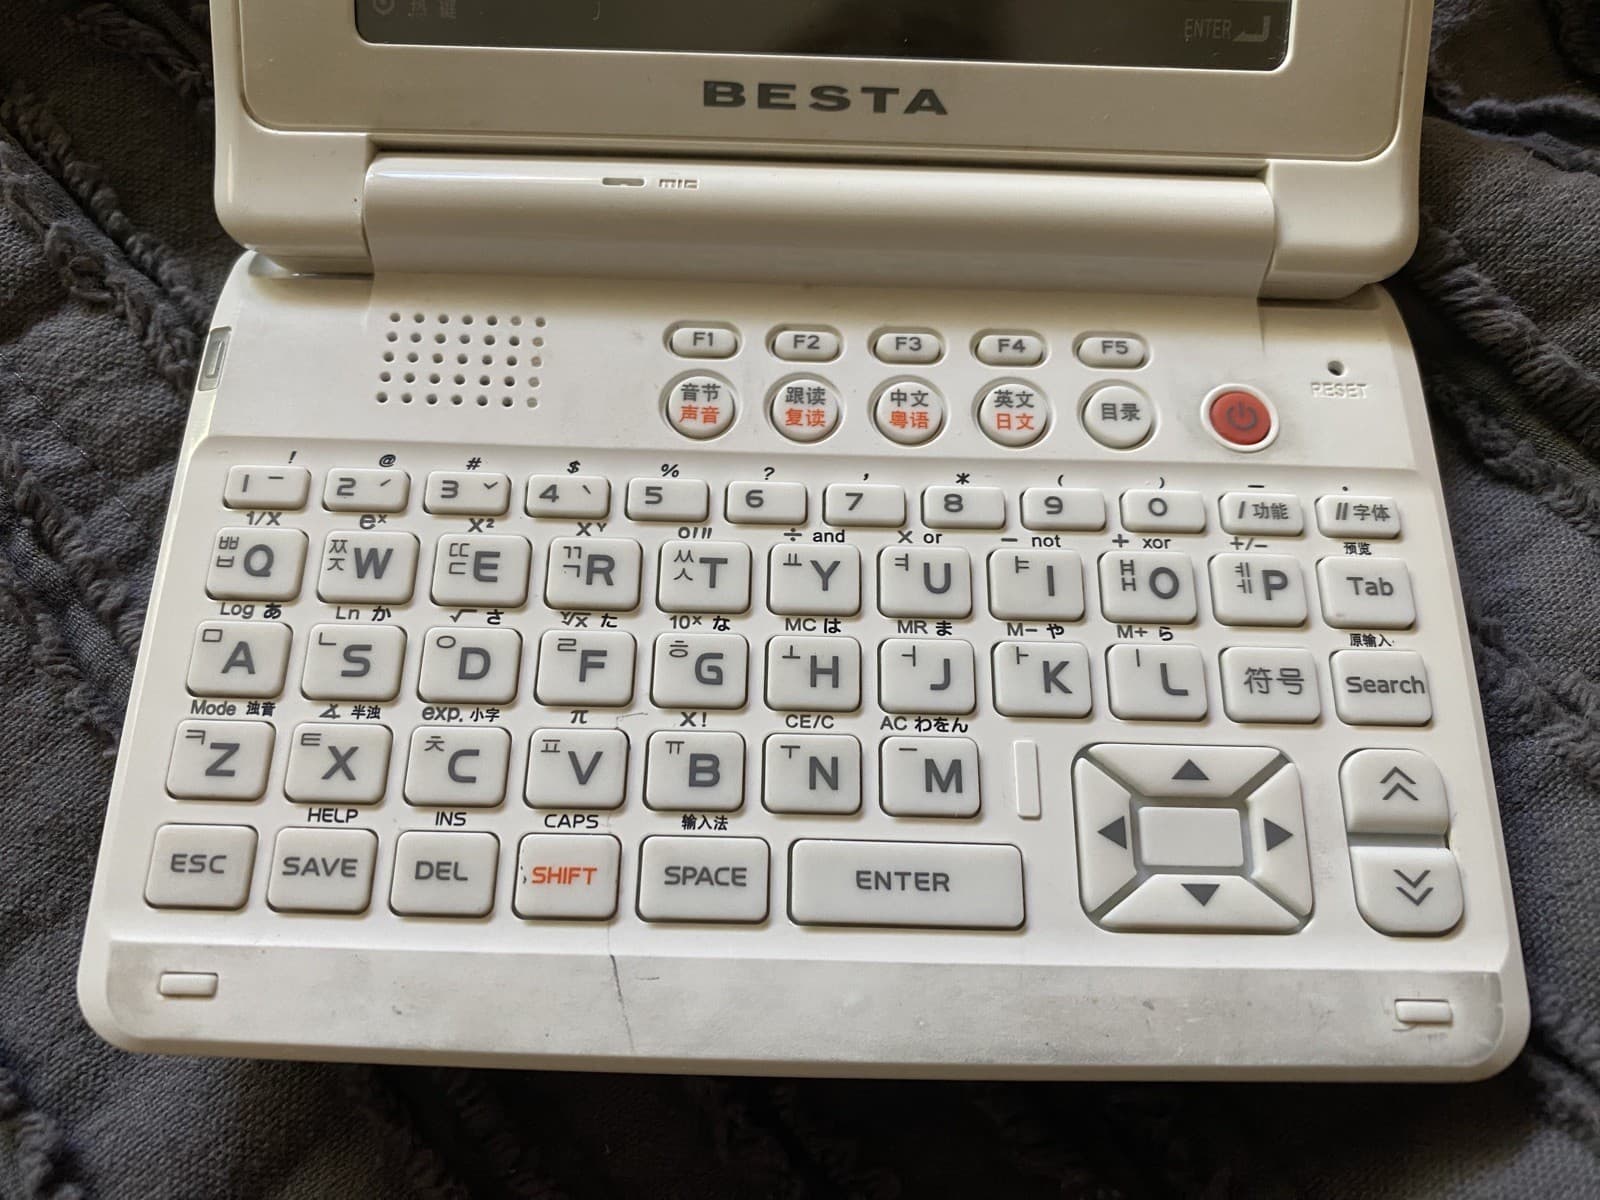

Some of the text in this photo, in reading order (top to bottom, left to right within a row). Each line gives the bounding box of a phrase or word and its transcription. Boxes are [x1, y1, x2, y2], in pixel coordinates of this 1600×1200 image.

[1184, 18, 1232, 40] ENTER
[702, 80, 949, 116] BESTA
[693, 332, 713, 346] F1
[794, 335, 820, 349] F2
[896, 337, 922, 351] F3
[998, 339, 1026, 353] F4
[1102, 341, 1128, 355] F5
[681, 383, 720, 402] 音节
[785, 387, 826, 405] 跟读
[891, 389, 928, 407] 中文
[994, 390, 1034, 408] 英文
[1311, 382, 1367, 400] RESET
[679, 405, 719, 424] 声音
[786, 408, 825, 427] 复读
[890, 411, 929, 429] 粤语
[1102, 403, 1140, 421] 目录
[997, 413, 1034, 430] 日文
[288, 451, 297, 463] !
[379, 454, 396, 467] @
[466, 457, 481, 470] #
[567, 460, 580, 473] $
[661, 464, 679, 477] %
[764, 467, 775, 480] ?
[337, 478, 356, 496] 2
[441, 480, 459, 498] 3
[1058, 475, 1064, 486] (
[1160, 477, 1165, 488] )
[539, 485, 559, 502] 4
[645, 486, 663, 504] 5
[746, 490, 764, 508] 6
[846, 493, 863, 511] 7
[944, 494, 963, 513] 8
[1044, 496, 1063, 514] 9
[1148, 498, 1168, 517] 0
[1252, 502, 1289, 520] 功能
[1353, 504, 1390, 521] 字体
[812, 529, 846, 543] and
[924, 534, 942, 544] or
[1031, 533, 1062, 549] not
[1143, 538, 1171, 549] xor
[1343, 542, 1373, 556] 预览
[244, 544, 274, 577] Q
[354, 548, 393, 579] W
[473, 551, 500, 582] E
[586, 554, 615, 586] R
[699, 557, 728, 588] T
[810, 560, 840, 591] Y
[924, 563, 951, 594] U
[1047, 566, 1055, 596] I
[1149, 567, 1179, 599] O
[1262, 570, 1288, 600] P
[1346, 577, 1394, 596] Tab
[219, 602, 282, 620] Log あ
[335, 605, 392, 622] Ln か
[485, 609, 503, 626] さ
[600, 612, 618, 628] た
[712, 616, 731, 632] な
[784, 618, 841, 634] MC は
[897, 620, 952, 636] MR ま
[1046, 623, 1065, 639] や
[1116, 625, 1174, 641] M+ ら
[1350, 633, 1392, 647] 原输入
[221, 641, 255, 674] A
[341, 645, 372, 677] S
[458, 647, 491, 680] D
[579, 650, 607, 682] F
[695, 653, 723, 685] G
[810, 655, 839, 688] H
[930, 659, 951, 691] J
[1043, 661, 1072, 694] K
[1160, 663, 1189, 696] L
[1244, 667, 1304, 695] 符号
[1346, 676, 1425, 694] Search
[190, 700, 276, 718] Mode 浊音
[351, 705, 382, 721] 半浊
[469, 707, 501, 723] 小字
[784, 714, 835, 730] CE/C
[880, 716, 969, 733] AC わをん
[205, 743, 240, 777] Z
[321, 746, 359, 781] X
[448, 749, 480, 783] C
[568, 751, 603, 785] V
[689, 753, 720, 787] B
[809, 756, 838, 790] N
[925, 759, 962, 793] M
[307, 808, 359, 824] HELP
[434, 811, 467, 827] INS
[544, 813, 599, 829] CAPS
[680, 814, 729, 832] 输入法
[171, 854, 227, 874] ESC
[282, 857, 358, 877] SAVE
[415, 861, 468, 881] DEL
[532, 867, 597, 885] SHIFT
[664, 866, 747, 887] SPACE
[856, 871, 949, 892] ENTER
